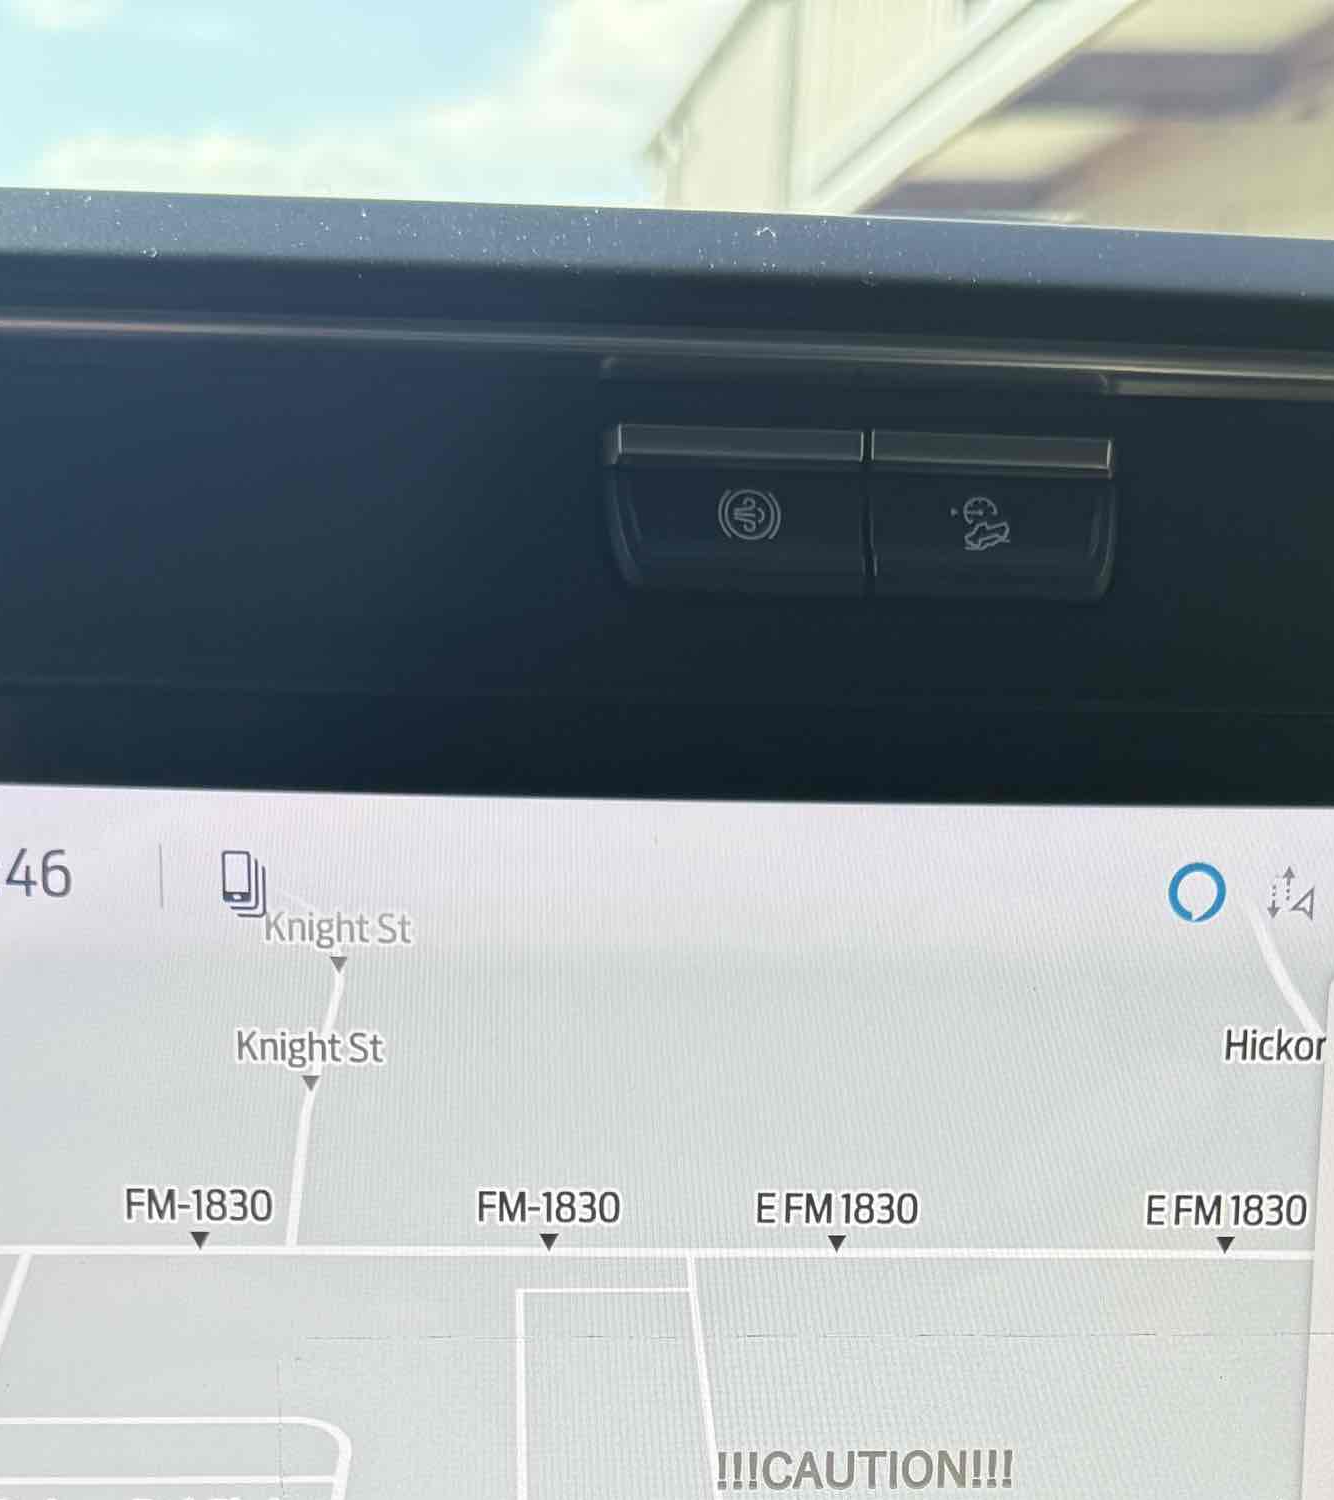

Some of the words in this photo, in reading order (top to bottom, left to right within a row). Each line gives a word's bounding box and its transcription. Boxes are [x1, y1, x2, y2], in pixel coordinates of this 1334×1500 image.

[265, 912, 370, 949] Knight
[374, 913, 413, 945] St
[235, 1030, 341, 1067] Knight
[347, 1031, 384, 1065] St
[1225, 1028, 1327, 1061] Hickor
[124, 1187, 274, 1224] FM-1830
[477, 1190, 622, 1225] FM-1830
[756, 1193, 777, 1225] E
[782, 1193, 835, 1225] FM
[839, 1192, 920, 1227] 1830
[1146, 1196, 1167, 1227] E
[1172, 1195, 1225, 1227] FM
[1229, 1193, 1309, 1228] 1830
[716, 1448, 1014, 1491] !!!CAUTION!!!
